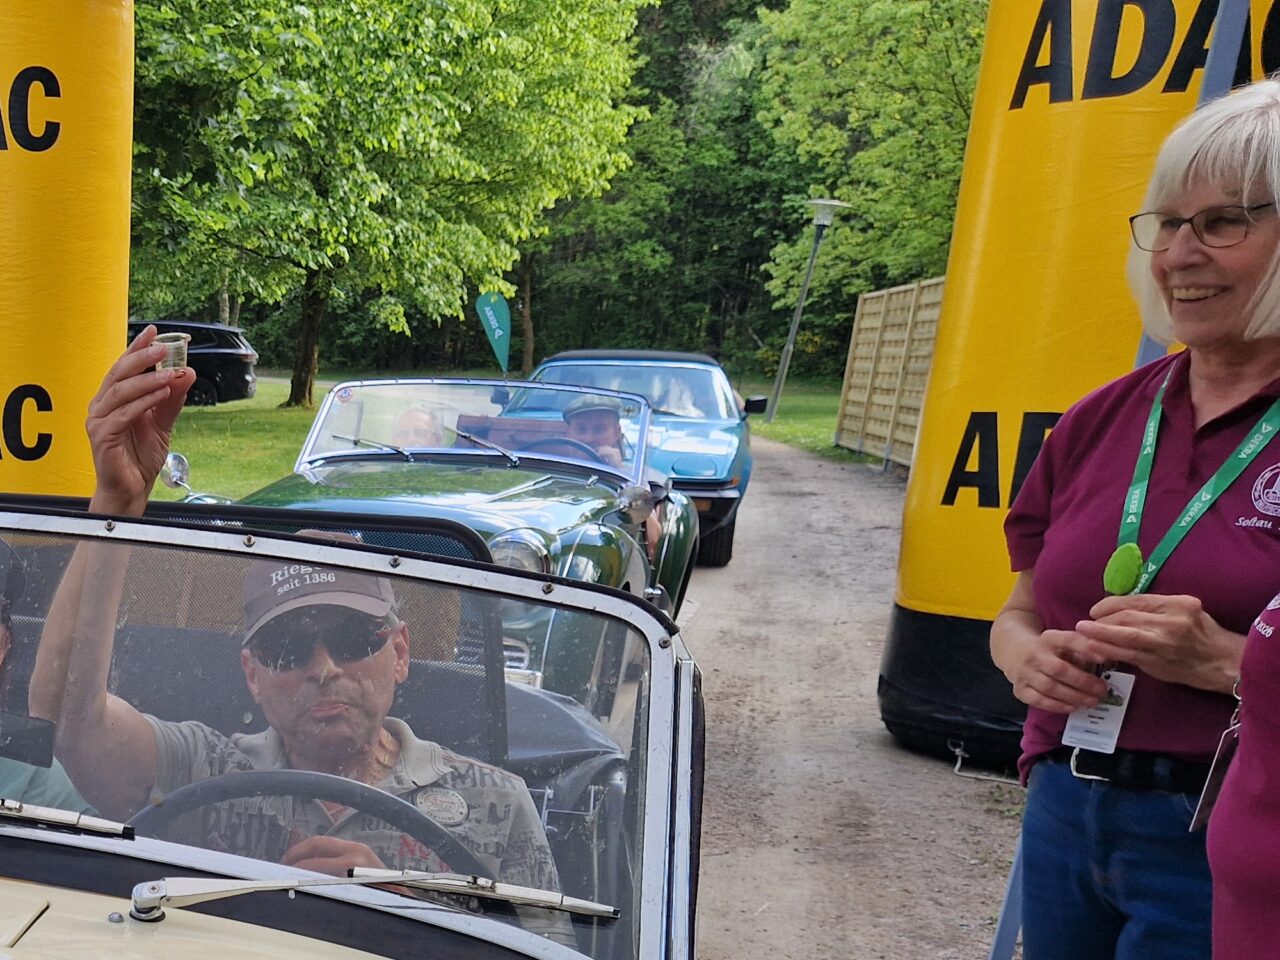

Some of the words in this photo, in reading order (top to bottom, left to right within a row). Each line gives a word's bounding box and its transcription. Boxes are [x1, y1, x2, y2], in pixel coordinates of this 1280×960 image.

[1008, 0, 1280, 111] ADA
[1238, 433, 1263, 459] DEKRA
[1179, 502, 1203, 527] DEKRA
[270, 565, 322, 588] Rie
[277, 579, 301, 596] seit
[304, 572, 336, 585] 1386
